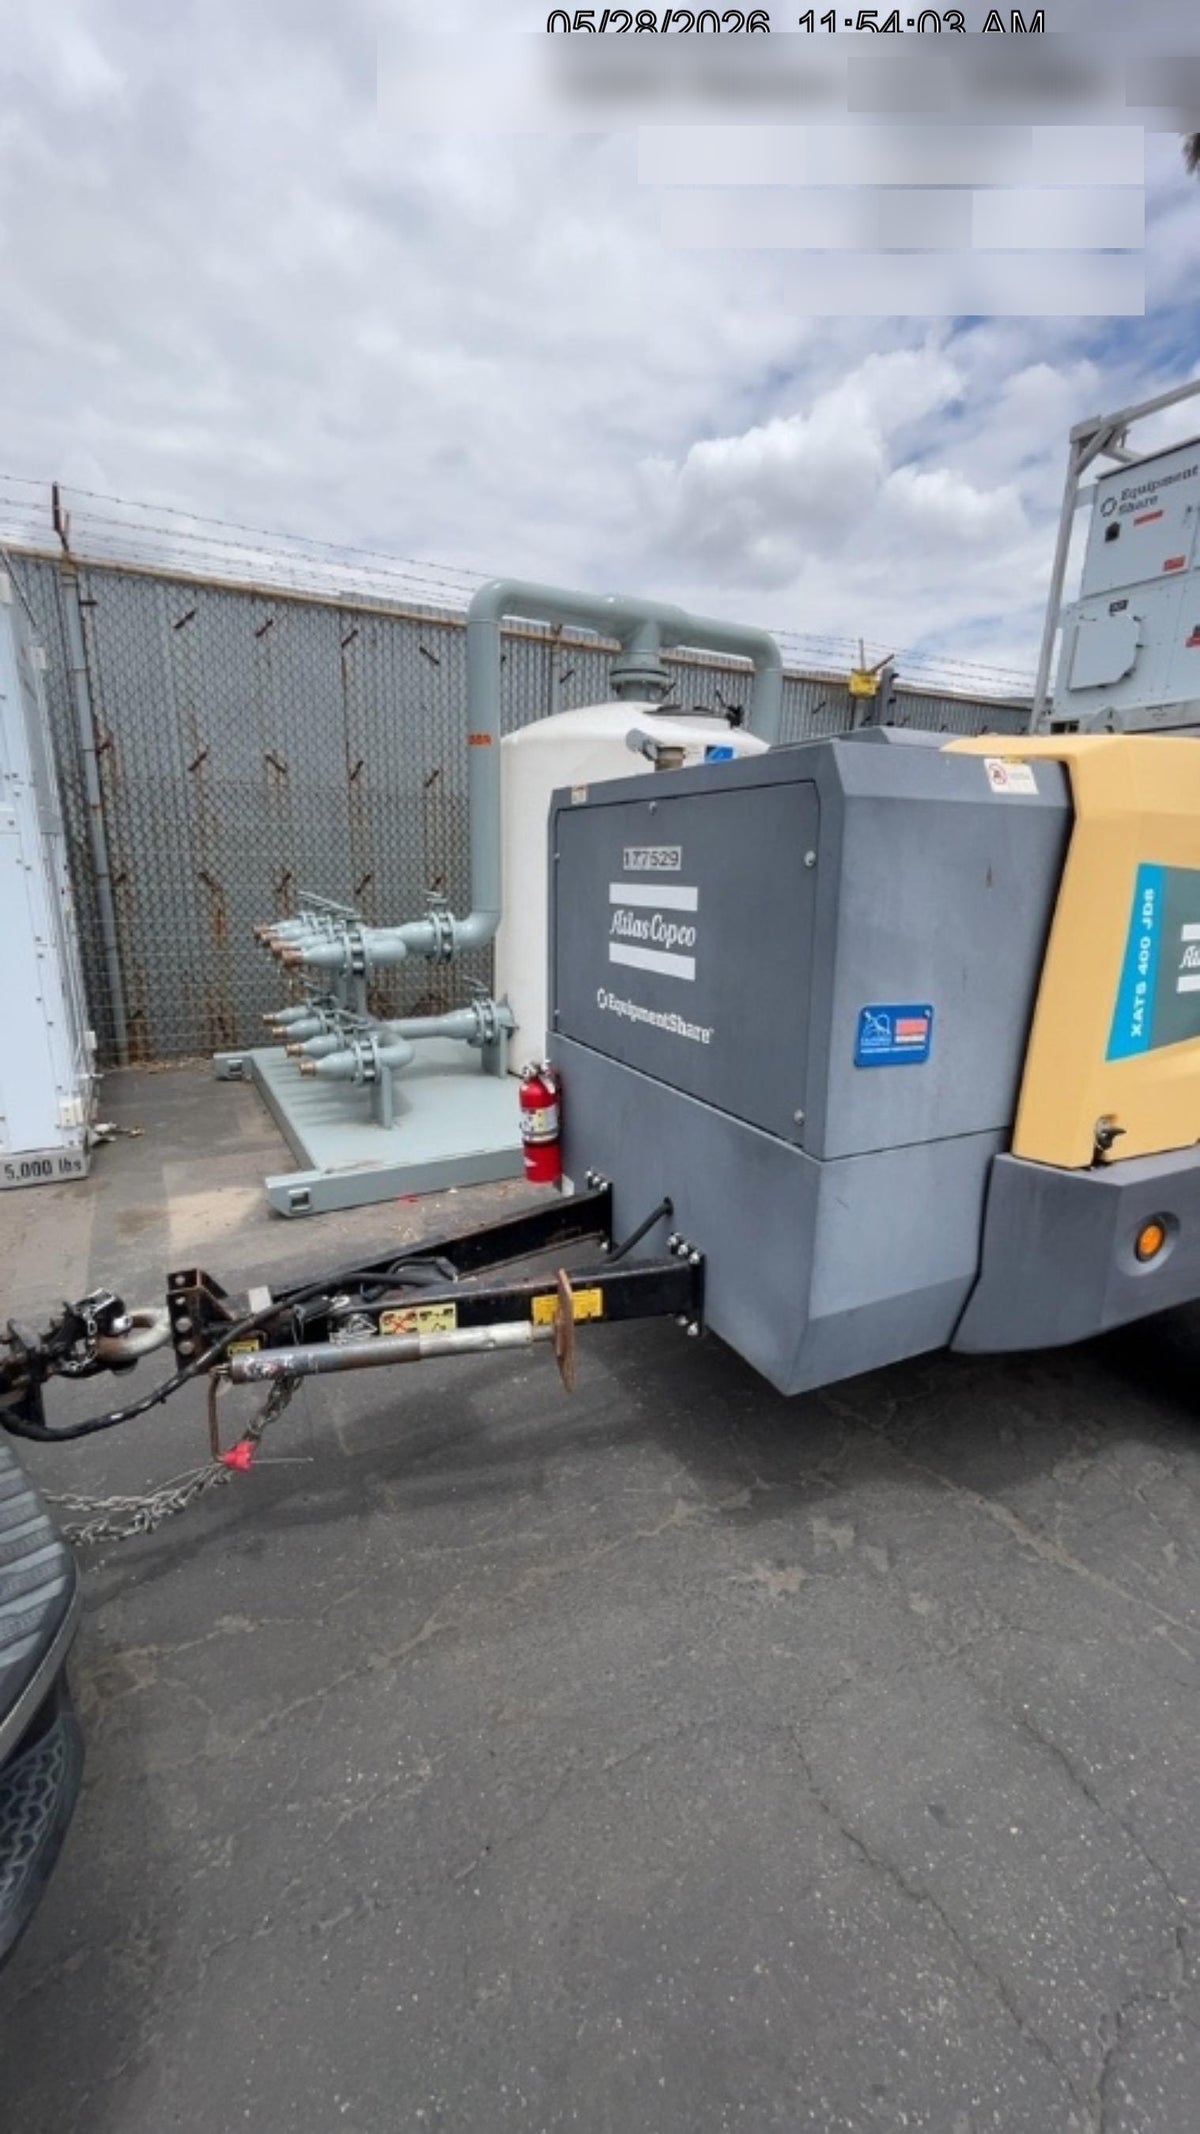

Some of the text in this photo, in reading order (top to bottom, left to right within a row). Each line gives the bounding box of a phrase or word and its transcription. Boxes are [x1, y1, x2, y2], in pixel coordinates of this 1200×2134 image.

[1121, 465, 1198, 500] Equipment
[624, 849, 680, 867] 177529
[609, 909, 696, 949] Atlas Copco
[1138, 936, 1151, 976] 400
[608, 992, 710, 1044] EquipmentShare
[1130, 980, 1147, 1037] XATS
[58, 1156, 82, 1174] lbs
